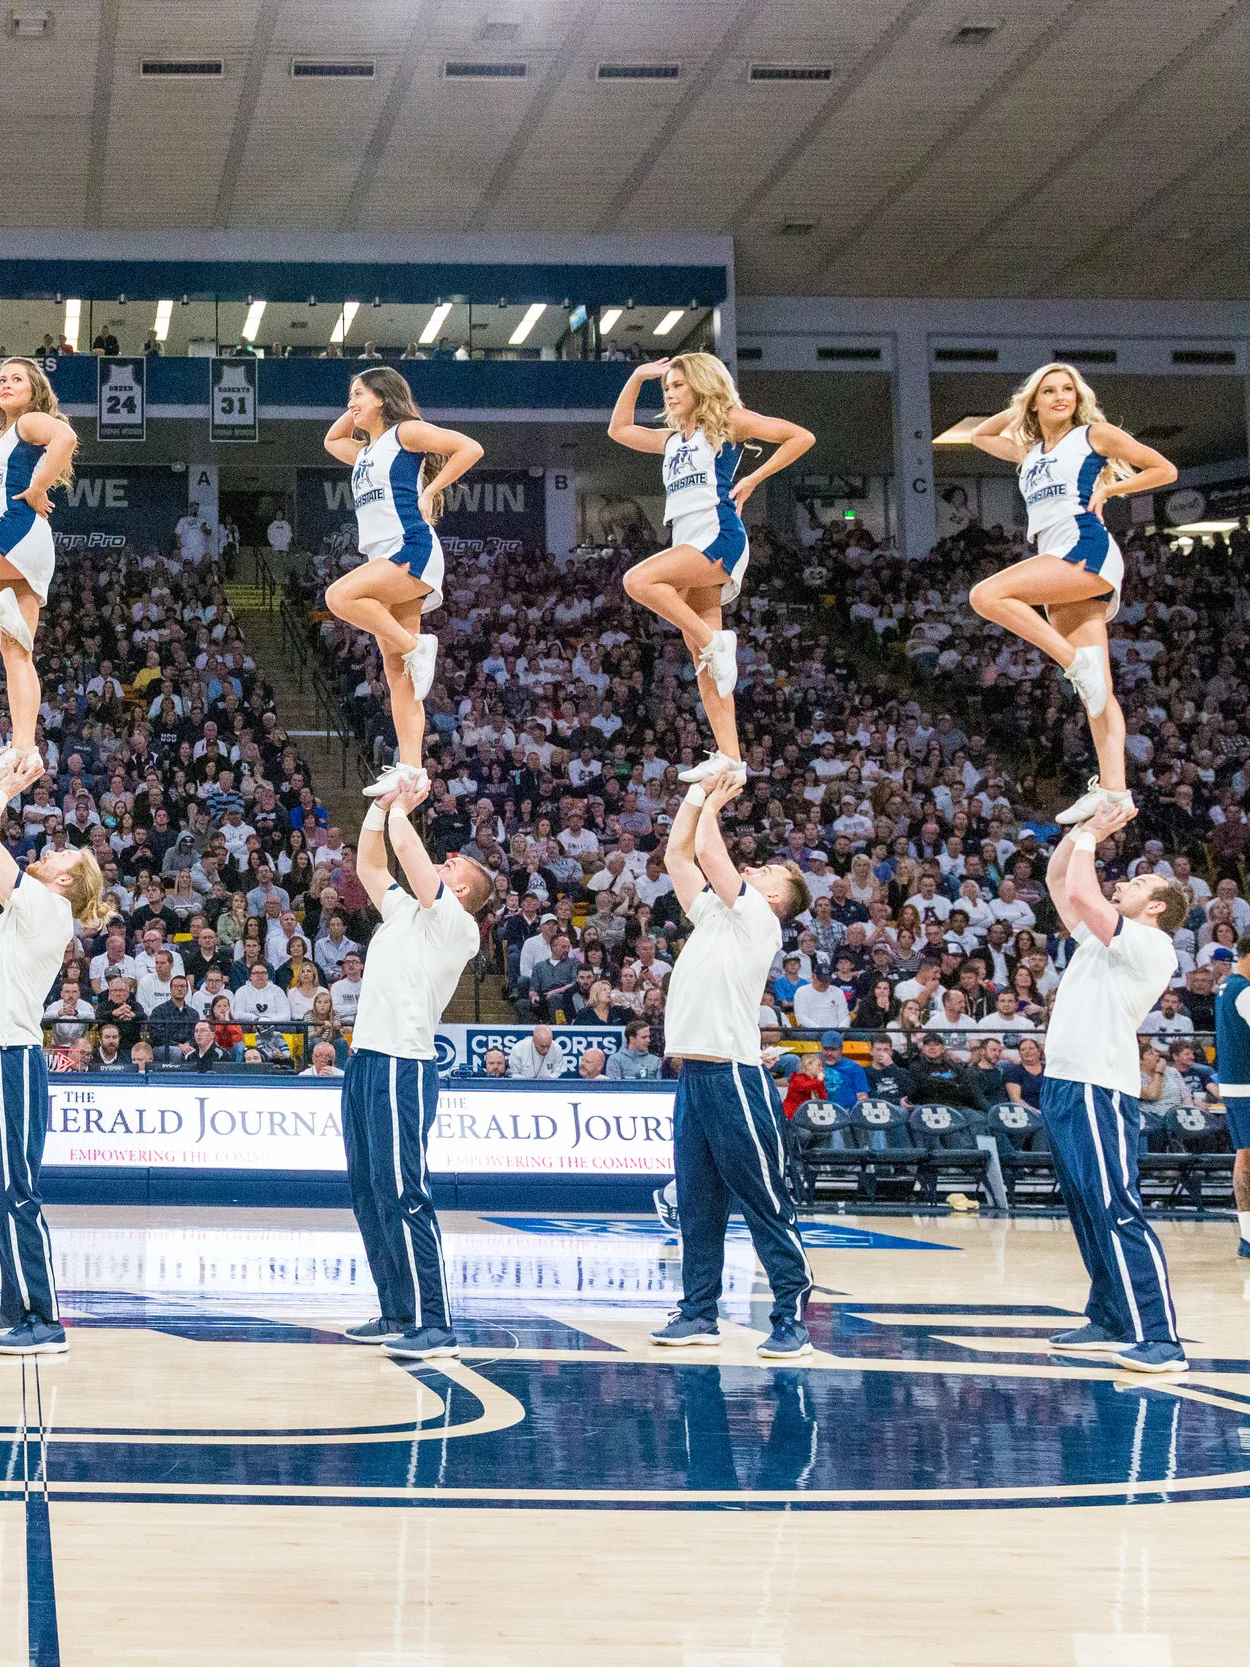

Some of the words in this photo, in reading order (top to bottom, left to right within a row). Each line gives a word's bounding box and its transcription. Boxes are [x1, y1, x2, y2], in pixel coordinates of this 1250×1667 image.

[106, 396, 137, 414] 24
[220, 397, 247, 414] 31
[197, 471, 210, 486] A
[555, 475, 568, 490] B
[912, 478, 927, 493] C
[66, 479, 129, 507] WE
[444, 483, 525, 512] WIN
[88, 533, 126, 548] Pro
[65, 1091, 95, 1103] THE
[194, 1097, 342, 1143] JOURNA
[429, 1113, 558, 1140] ERALD
[567, 1102, 674, 1149] JOUR
[70, 1148, 176, 1162] EMPOWERING
[181, 1151, 209, 1163] THE
[446, 1154, 552, 1168] EMPOWERING
[558, 1156, 588, 1168] THE
[592, 1157, 671, 1169] COMMUNI
